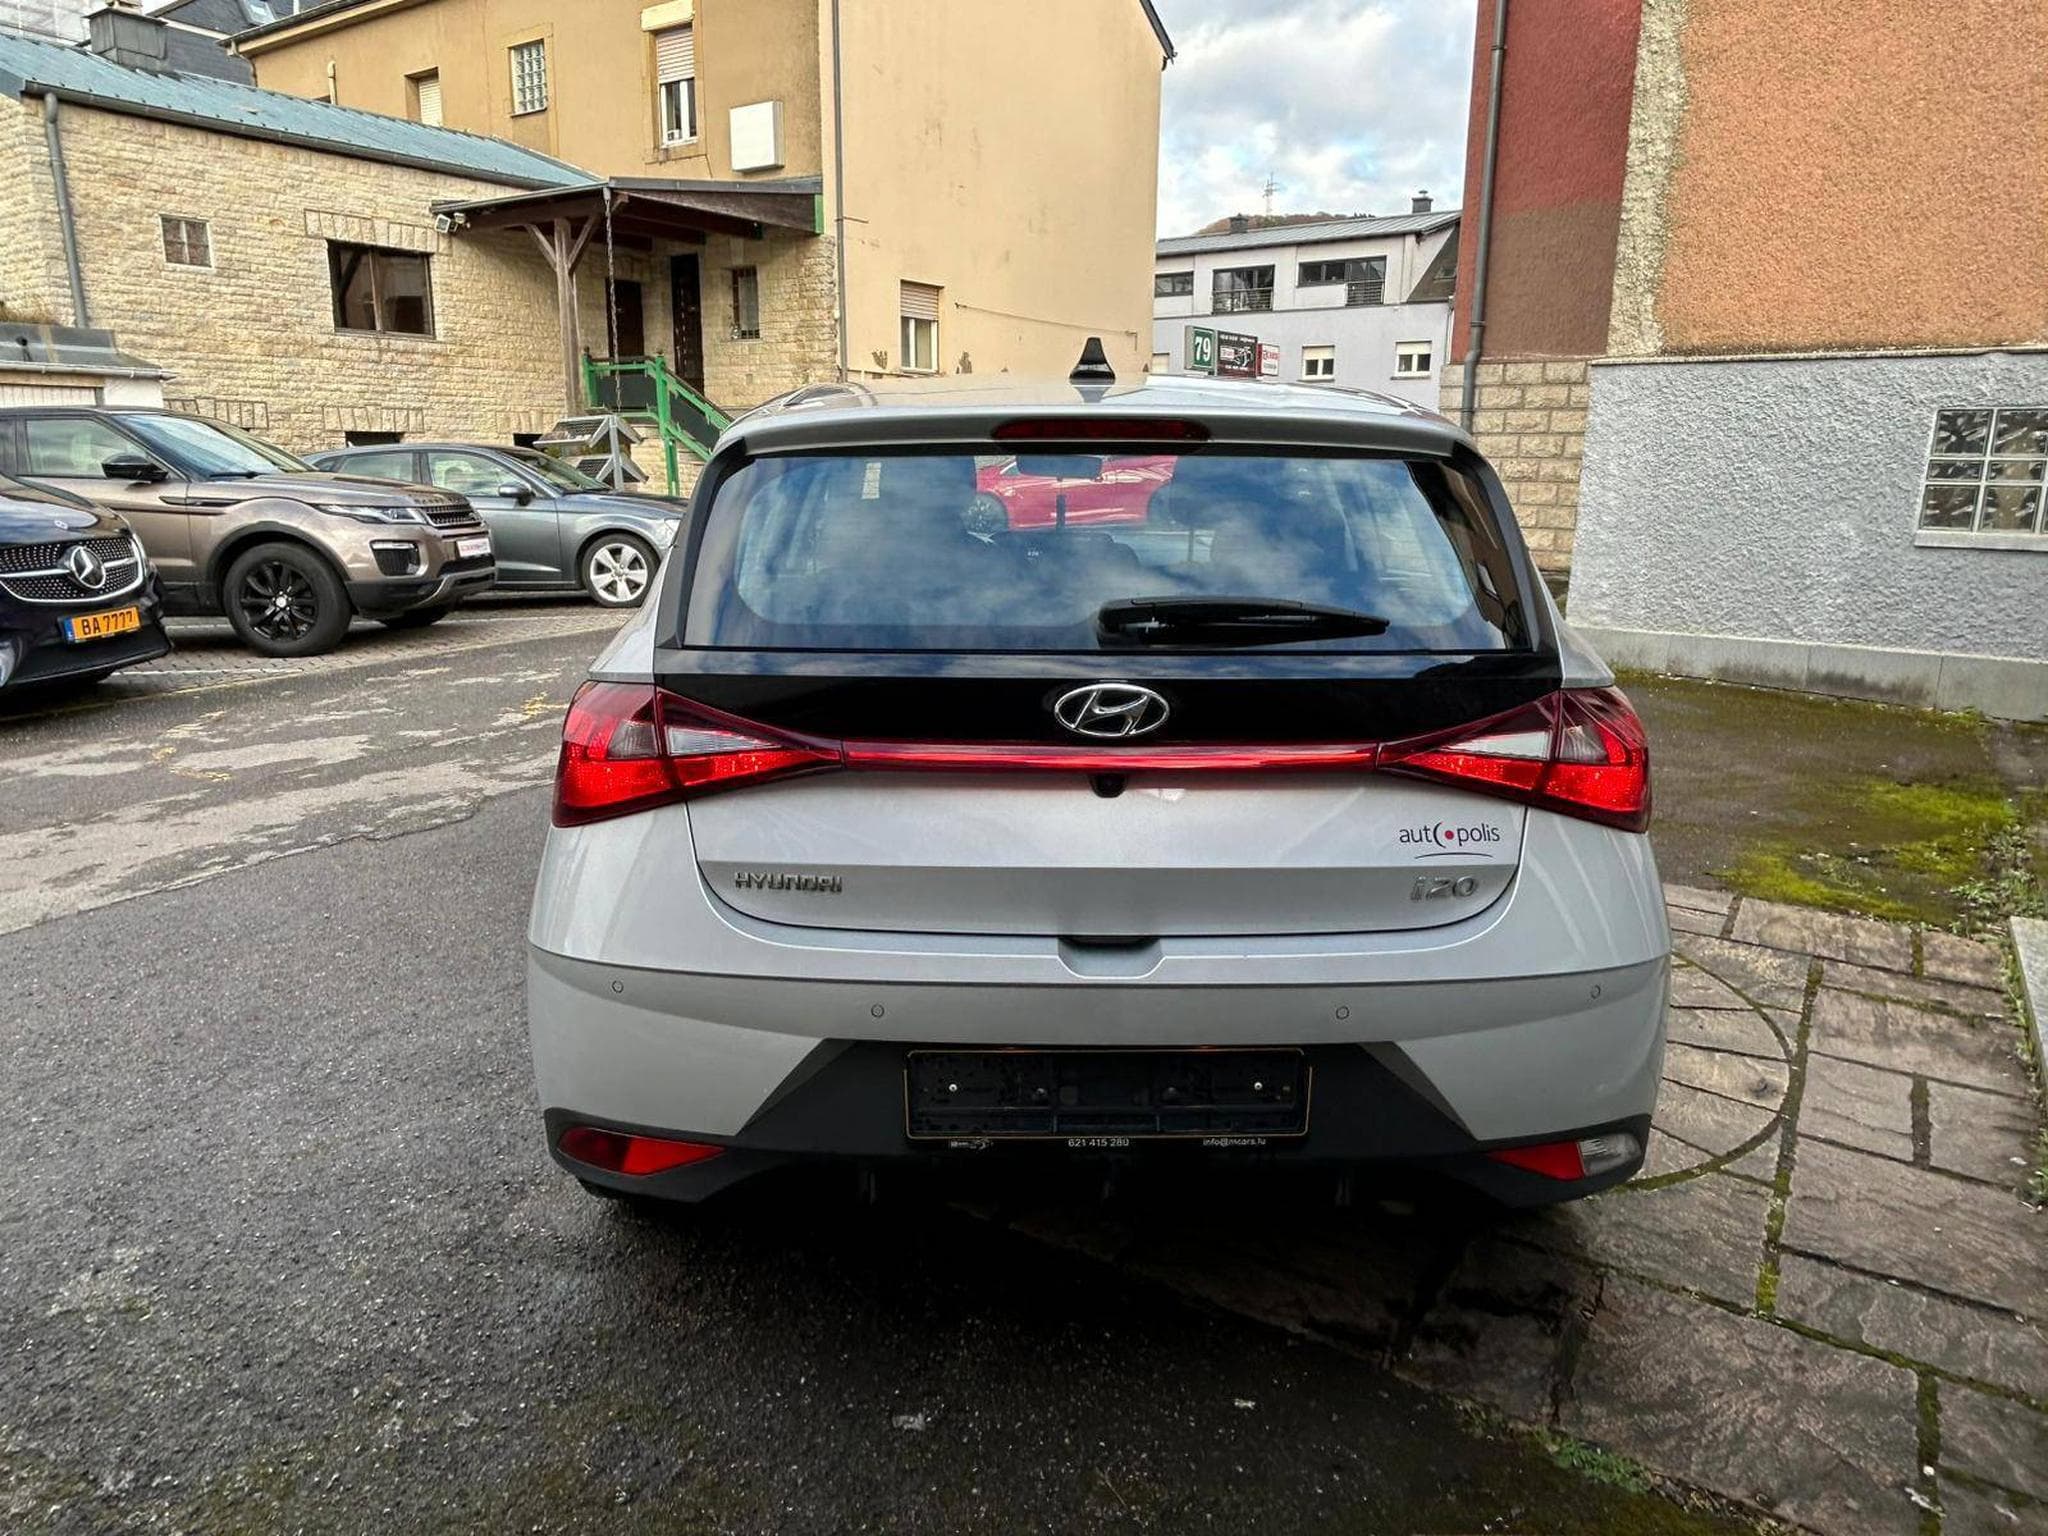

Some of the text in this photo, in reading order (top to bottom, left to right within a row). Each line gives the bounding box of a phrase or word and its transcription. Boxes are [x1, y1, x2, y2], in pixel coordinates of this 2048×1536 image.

[1195, 336, 1211, 361] 79
[81, 611, 133, 635] BA 7777
[735, 872, 842, 893] HYUNDAI
[1068, 1138, 1086, 1147] 621
[1089, 1138, 1108, 1147] 415
